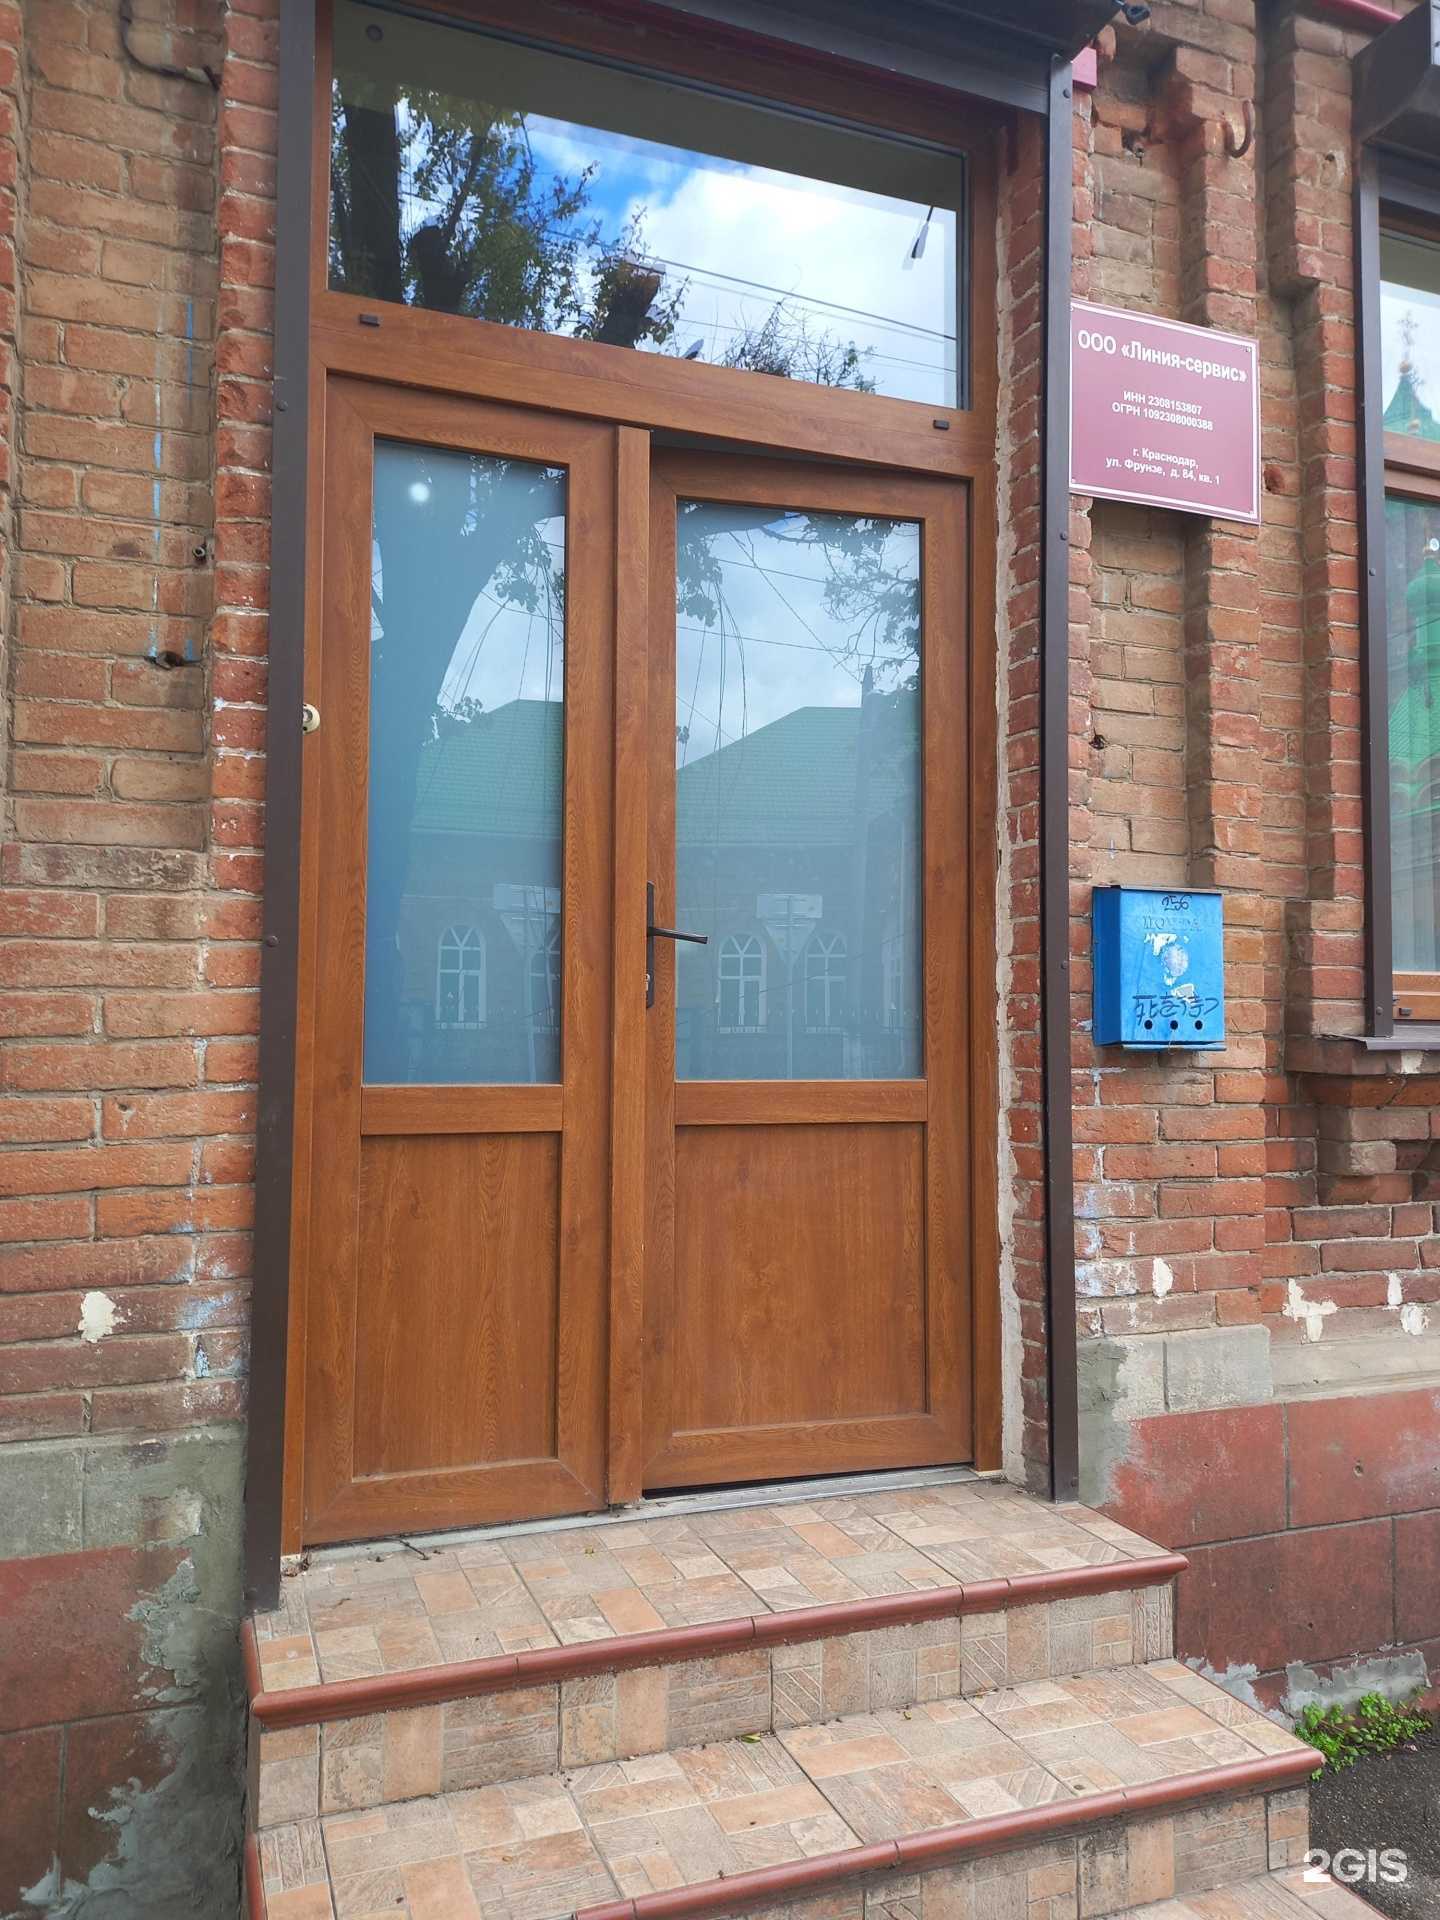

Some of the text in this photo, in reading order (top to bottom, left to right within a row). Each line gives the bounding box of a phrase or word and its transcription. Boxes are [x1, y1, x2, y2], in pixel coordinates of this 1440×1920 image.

[1077, 329, 1248, 382] ООО «Линия-сервис»
[1123, 391, 1203, 415] ИНН 2308153807
[1112, 402, 1214, 431] ОГРН 1092308000388
[1105, 457, 1122, 468] ул.
[1124, 458, 1166, 477] Фрунзе,
[1170, 468, 1181, 479] д.
[1198, 473, 1213, 484] кв.
[1215, 475, 1220, 485] 1
[1132, 448, 1199, 470] г. Краснодар,
[1161, 894, 1193, 912] 256
